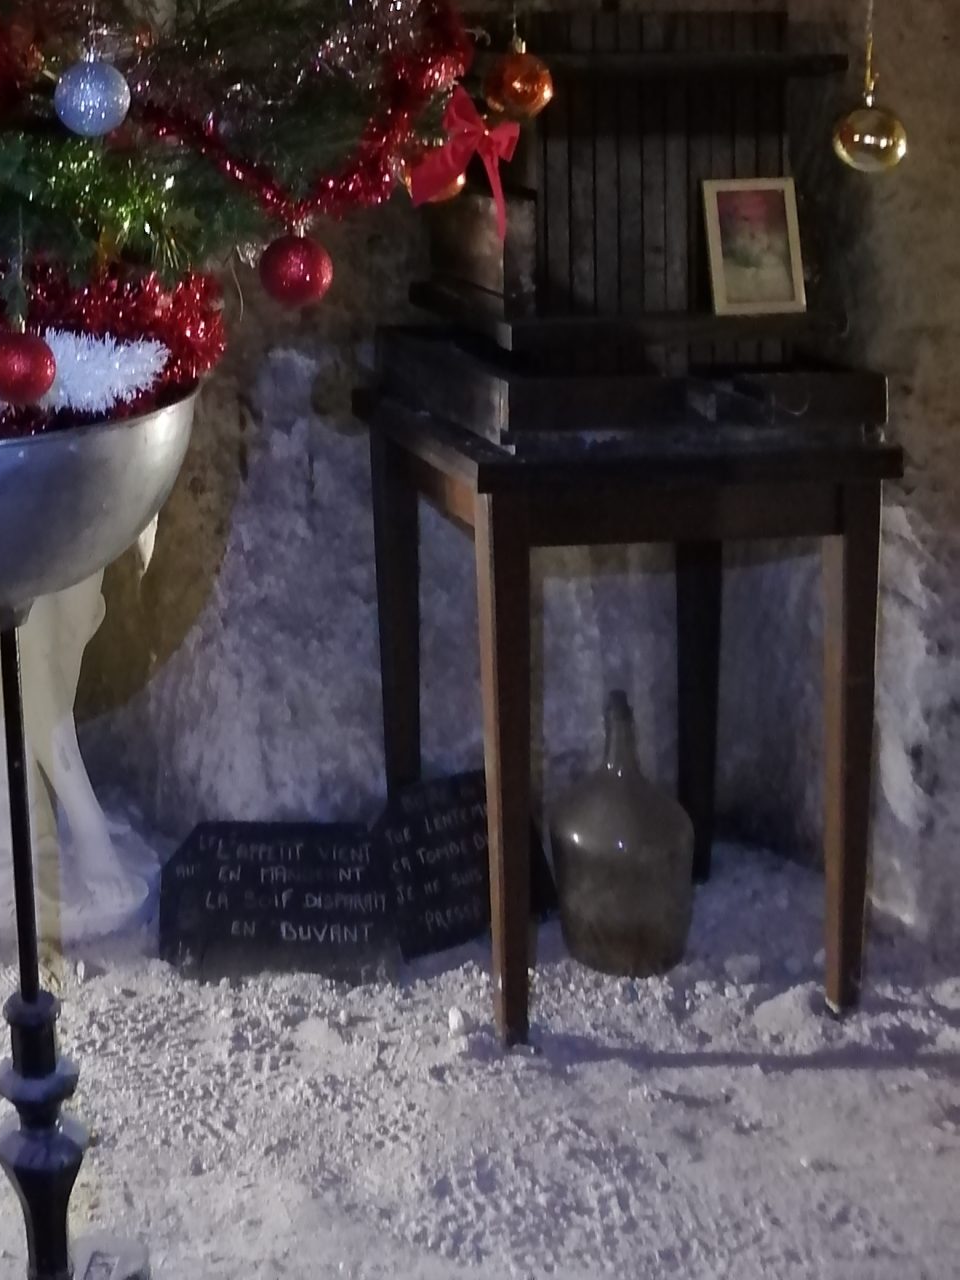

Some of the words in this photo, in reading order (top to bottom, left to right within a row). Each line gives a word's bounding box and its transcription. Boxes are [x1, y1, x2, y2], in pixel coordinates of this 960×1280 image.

[218, 864, 242, 884] EN
[205, 890, 230, 911] LA
[230, 919, 257, 939] EN
[280, 919, 375, 945] BUVANT
